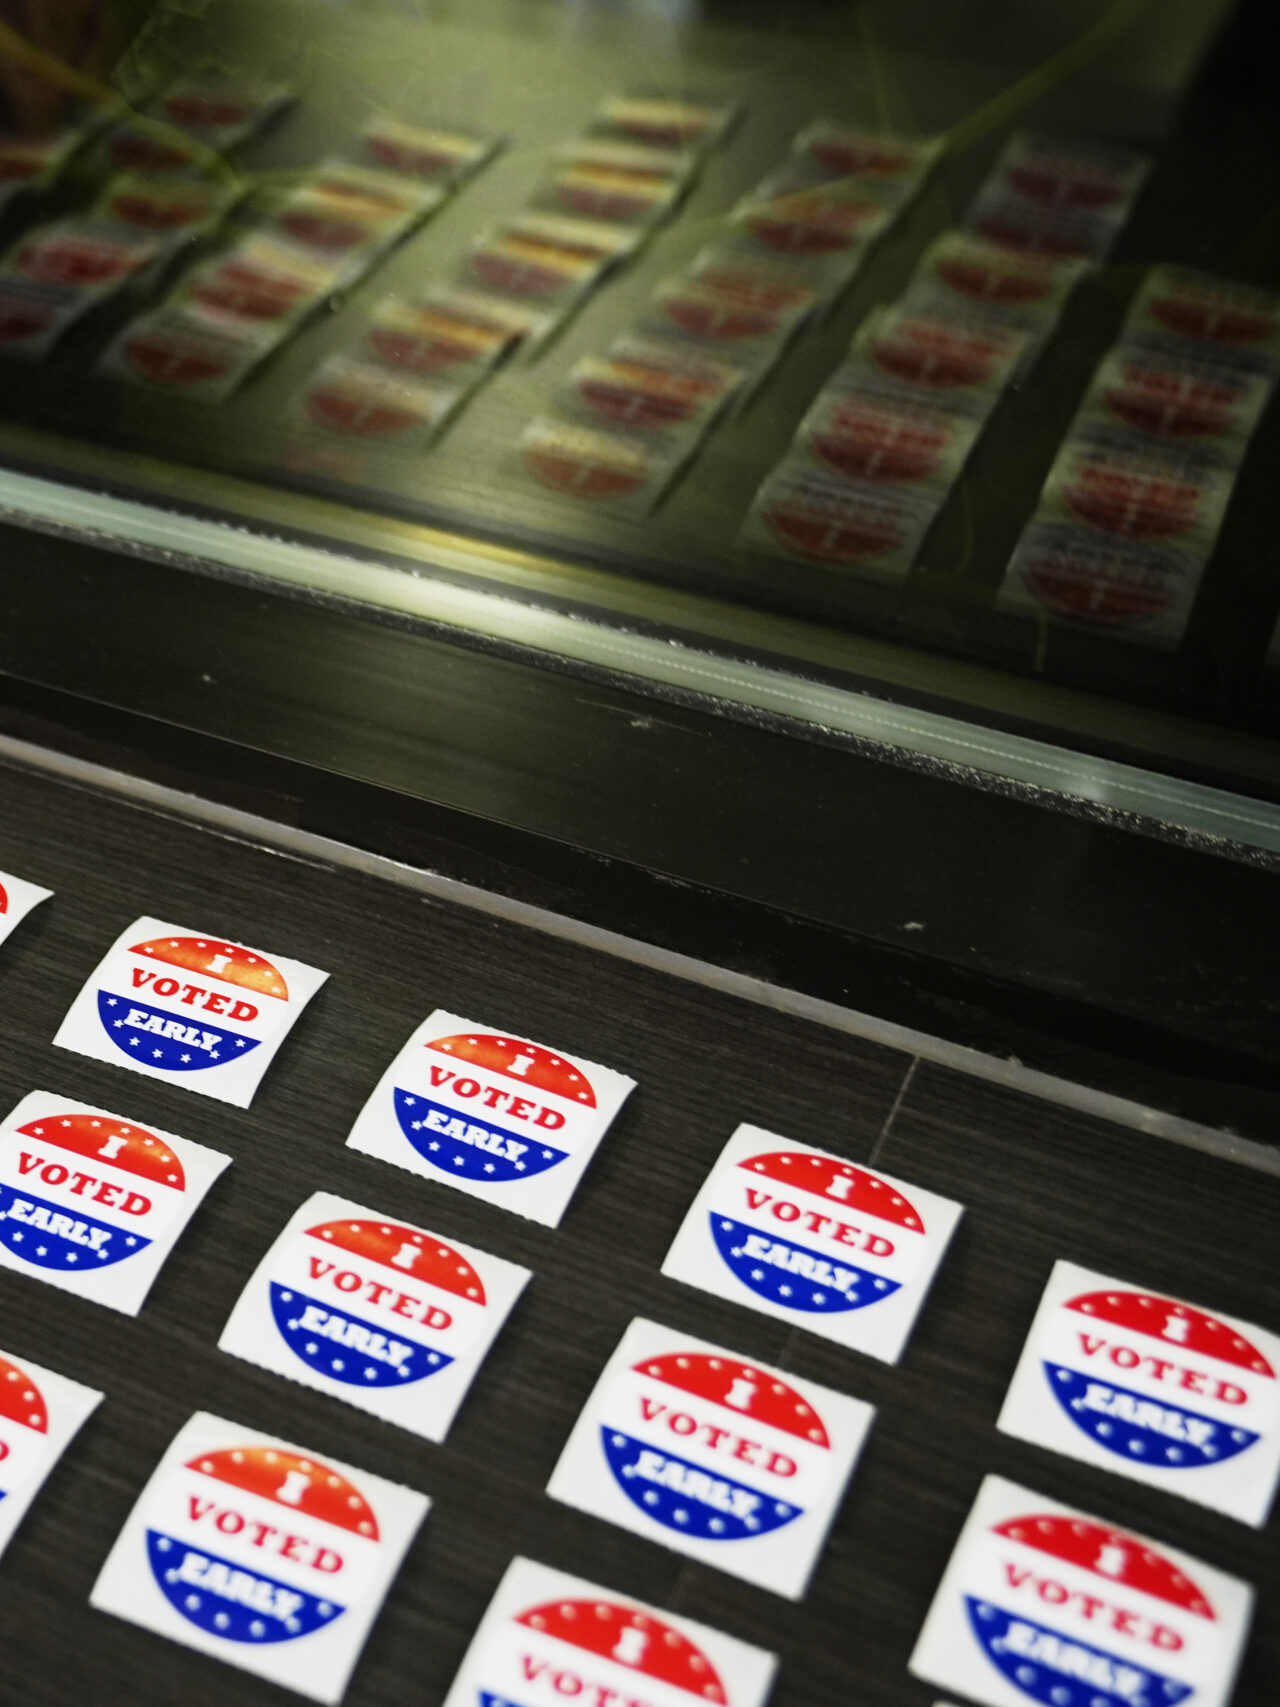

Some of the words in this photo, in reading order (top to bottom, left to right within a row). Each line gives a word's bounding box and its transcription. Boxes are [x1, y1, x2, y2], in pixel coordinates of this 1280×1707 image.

[204, 953, 234, 975] I
[130, 968, 258, 1021] VOTED
[123, 1008, 223, 1051] EARLY
[506, 1053, 535, 1076] I
[428, 1065, 566, 1130] VOTED
[97, 1135, 129, 1159] I
[421, 1109, 528, 1161] EARLY
[19, 1152, 152, 1216] VOTED
[825, 1174, 854, 1200] I
[6, 1198, 112, 1250] EARLY
[745, 1188, 895, 1257] VOTED
[391, 1242, 422, 1270] I
[740, 1234, 859, 1291] EARLY
[308, 1257, 452, 1330] VOTED
[299, 1305, 413, 1366] EARLY
[724, 1378, 756, 1410] I
[1077, 1333, 1248, 1405] VOTED
[639, 1398, 798, 1477] VOTED
[1082, 1383, 1214, 1444] EARLY
[276, 1470, 311, 1505] I
[634, 1450, 760, 1519] EARLY
[190, 1496, 343, 1573] VOTED
[178, 1551, 303, 1620] EARLY
[1004, 1563, 1184, 1651] VOTED
[613, 1627, 647, 1665] I
[521, 1655, 652, 1707] VOT
